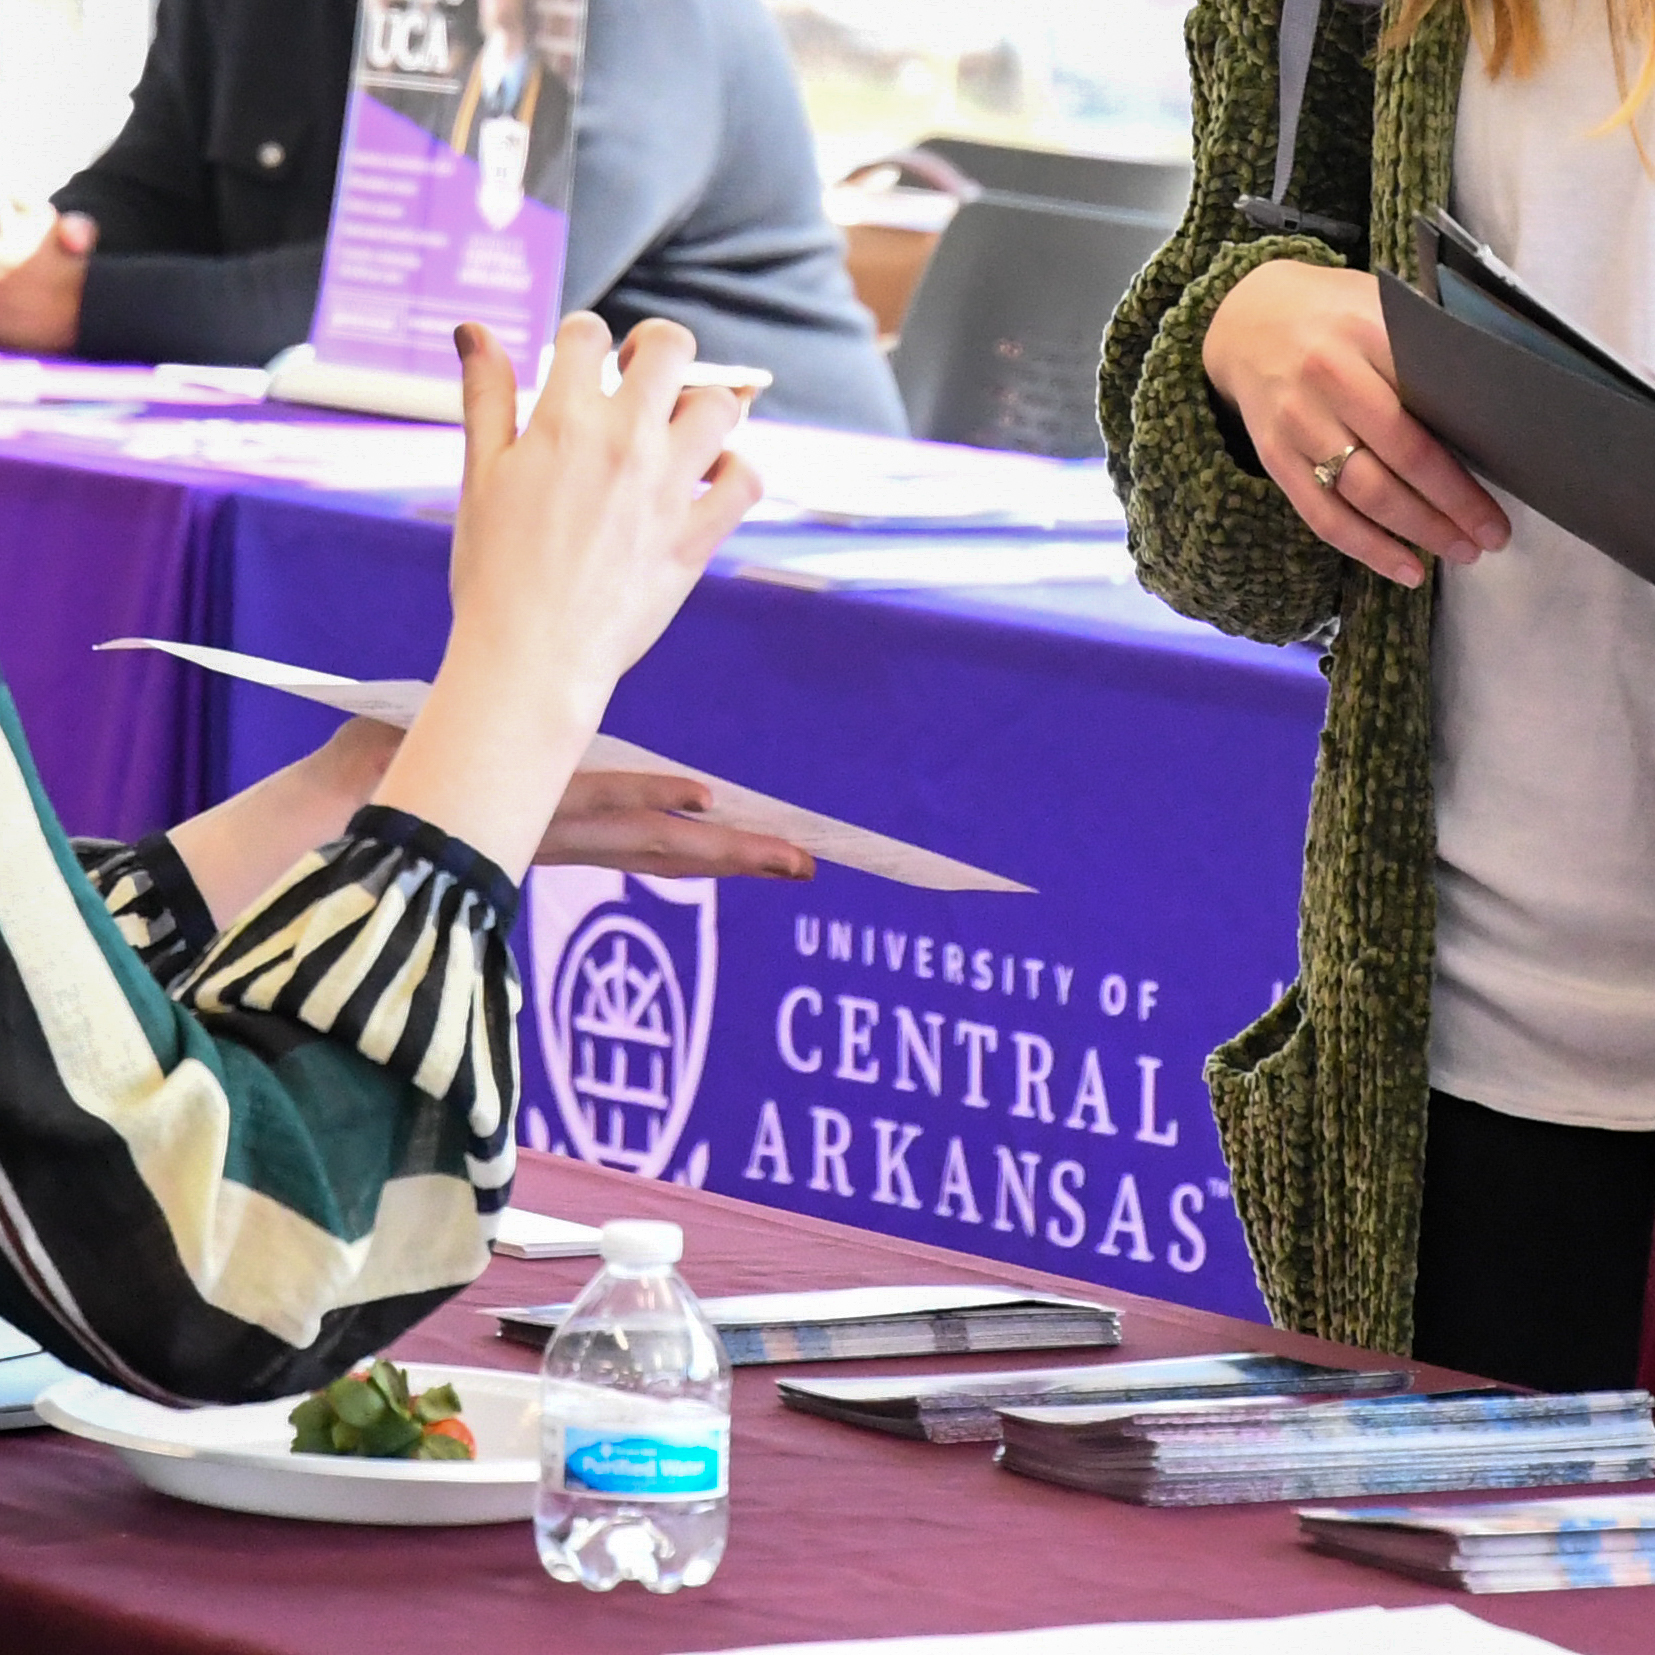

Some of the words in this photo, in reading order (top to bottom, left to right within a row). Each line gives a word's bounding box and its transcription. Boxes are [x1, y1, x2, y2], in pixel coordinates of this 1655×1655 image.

[366, 10, 451, 74] UCA
[795, 915, 1075, 1007] UNIVERSITY
[1099, 973, 1160, 1021] OF
[776, 985, 1179, 1148] CENTRAL
